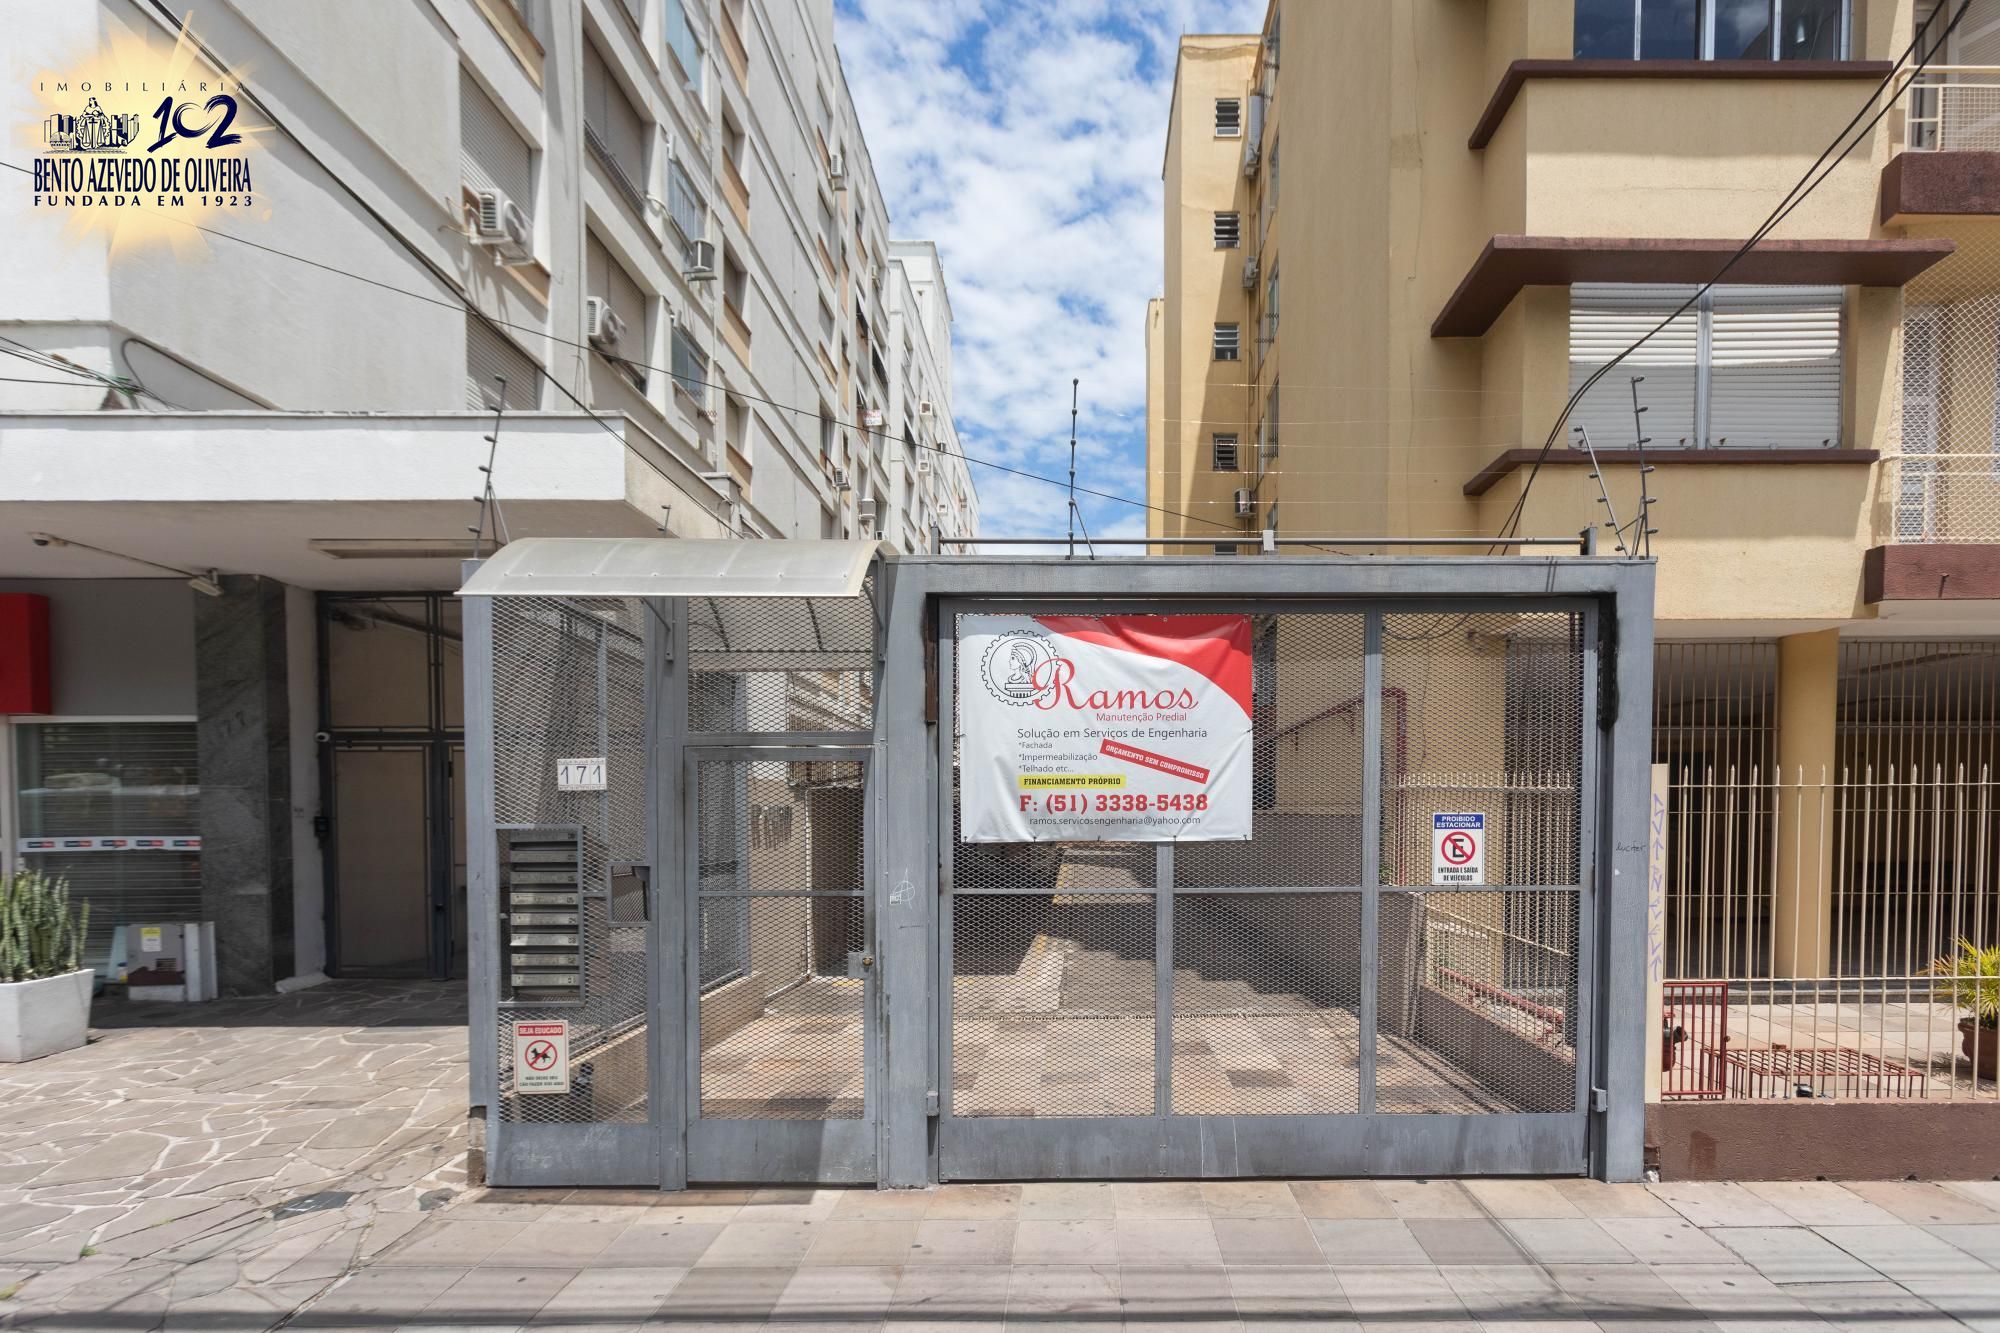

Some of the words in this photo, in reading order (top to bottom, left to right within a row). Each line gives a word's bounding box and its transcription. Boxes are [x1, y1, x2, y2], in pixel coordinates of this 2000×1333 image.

[1031, 658, 1199, 711] Ramos
[1096, 712, 1154, 723] Manutenção
[1156, 712, 1188, 722] Predial
[1017, 728, 1060, 740] Solução
[1063, 730, 1081, 738] em
[1083, 727, 1129, 740] Serviços
[1131, 728, 1145, 738] de
[1148, 728, 1208, 741] Engenharia
[1105, 744, 1144, 761] ORÇAMENTO
[1144, 756, 1159, 766] SEM
[1159, 760, 1205, 779] COMPROMISSO
[560, 765, 601, 784] 171
[1023, 778, 1086, 786] FINANCIAMENTO
[1088, 776, 1121, 785] PRÓPRIO
[1019, 794, 1038, 812] F:
[1046, 793, 1088, 815] (51)
[1095, 793, 1208, 812] 3338-5438
[1029, 815, 1201, 827] ramos.servicosengenharia@yahoo.com
